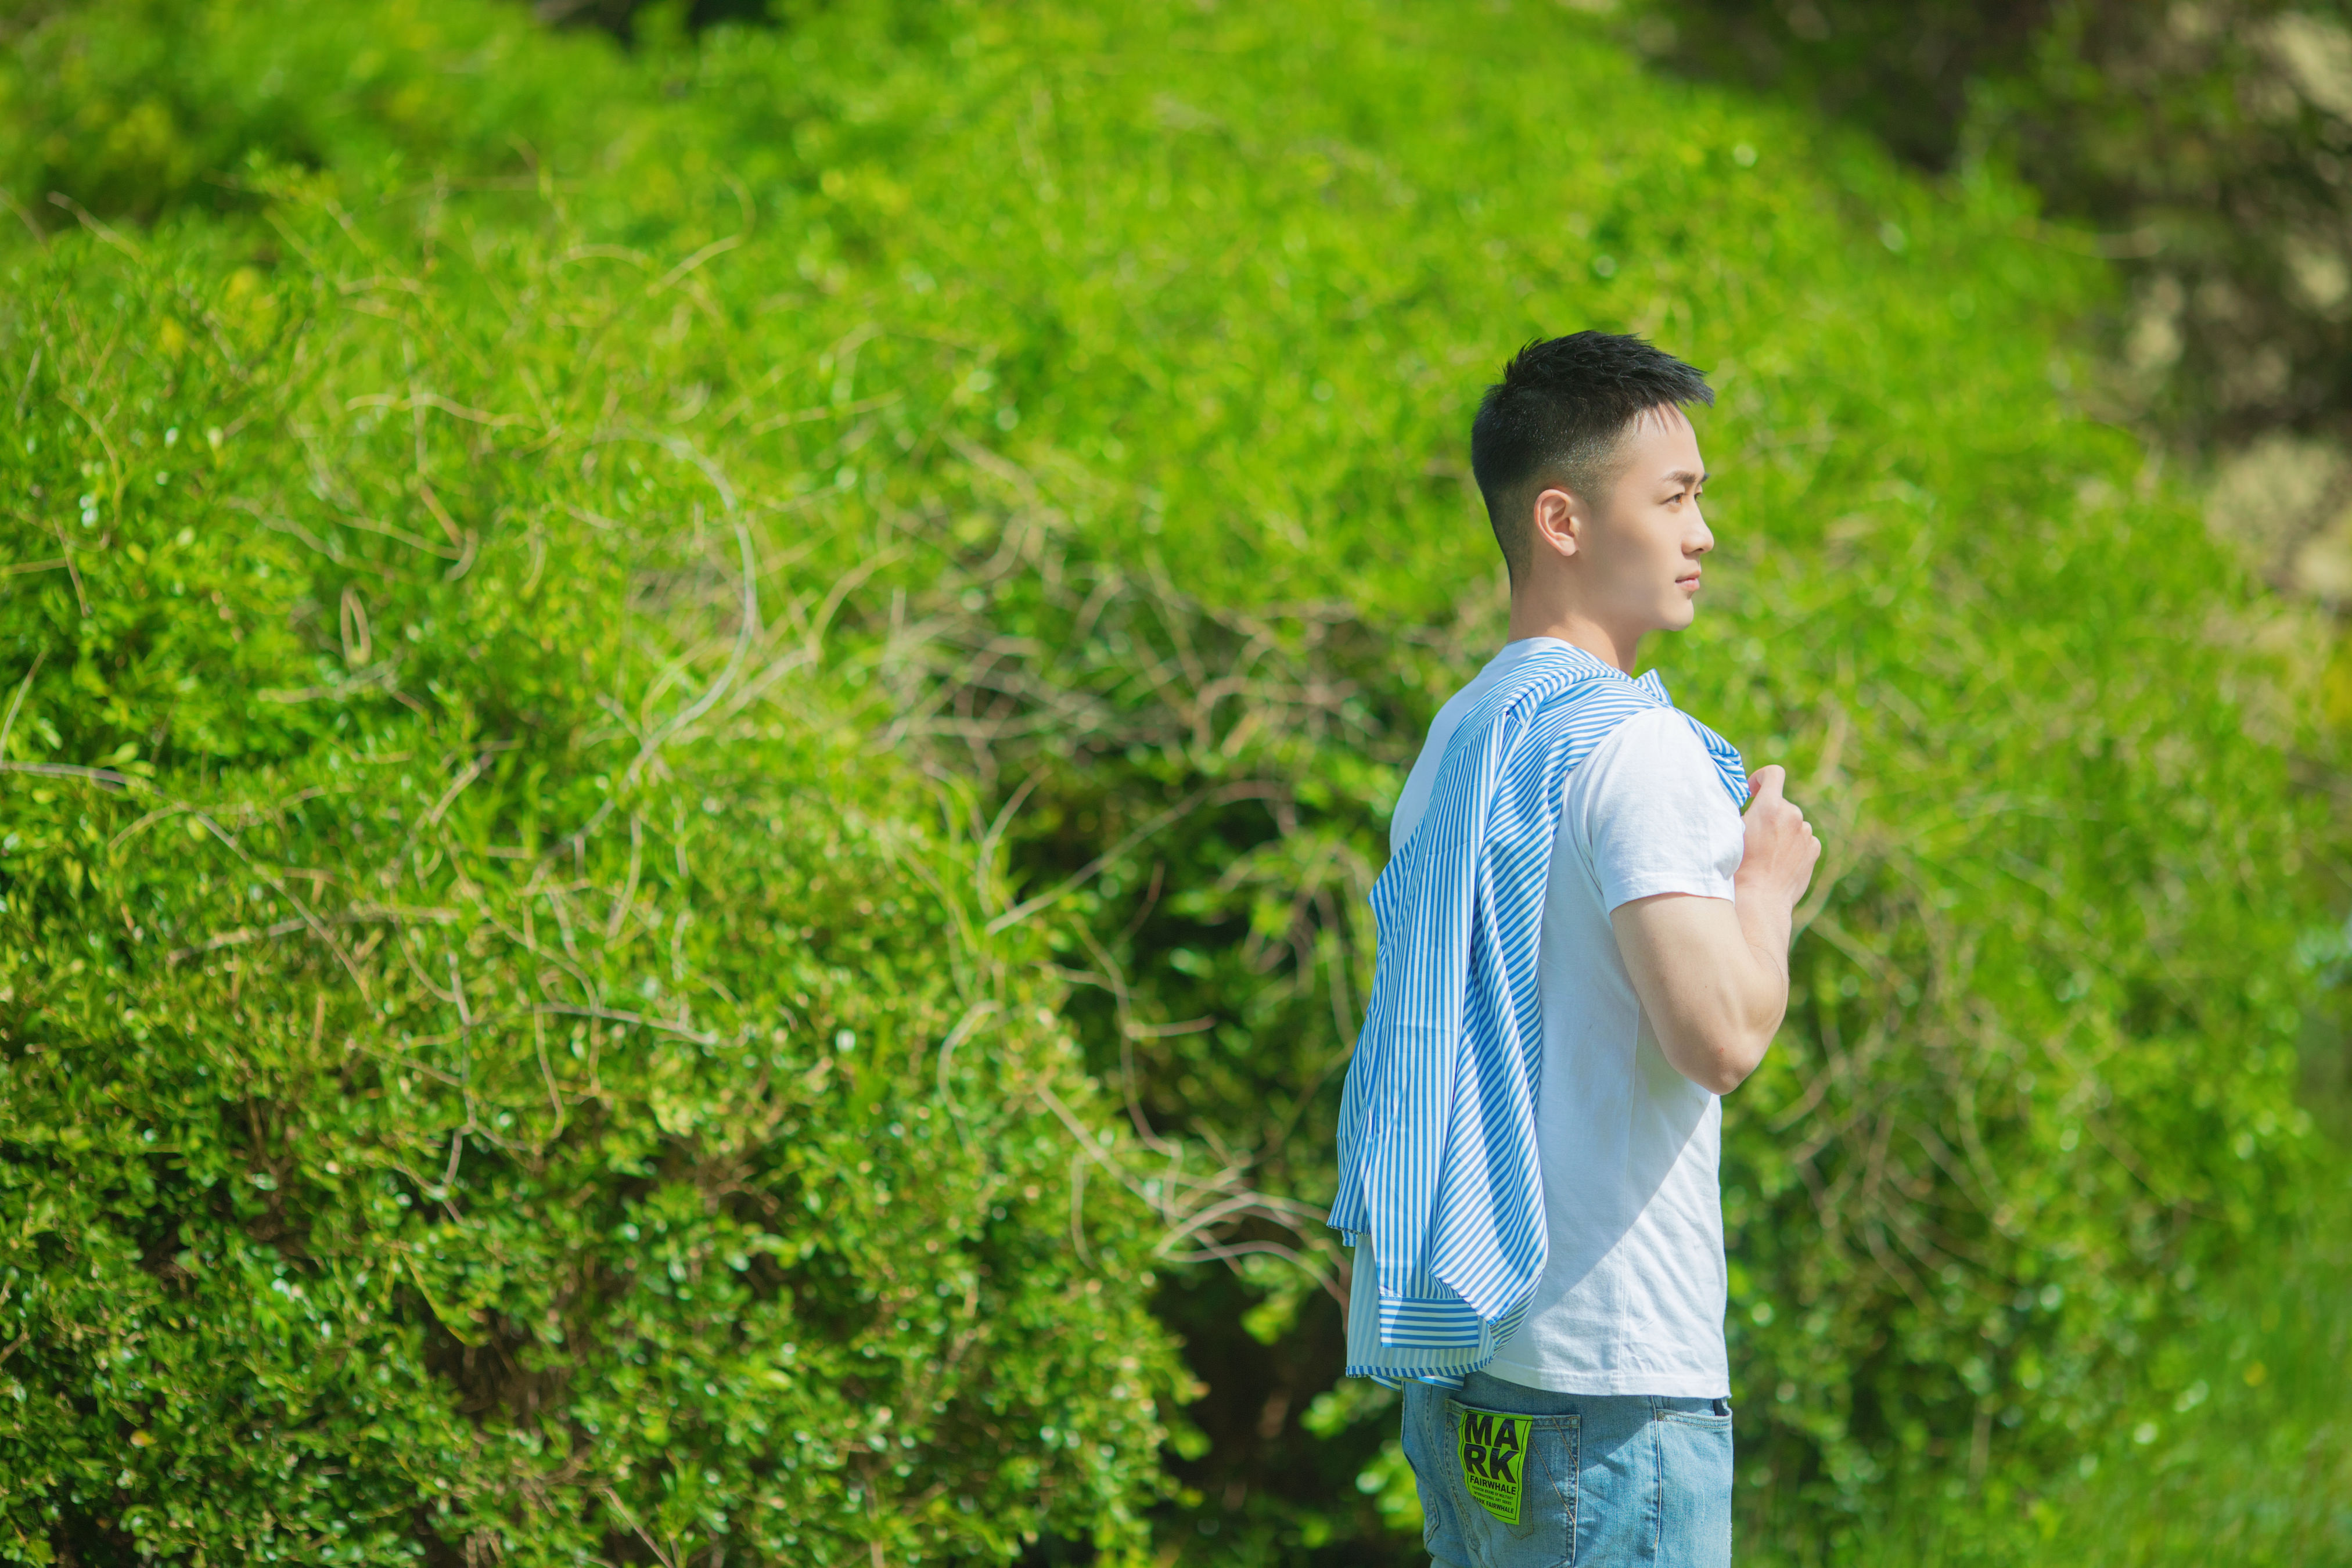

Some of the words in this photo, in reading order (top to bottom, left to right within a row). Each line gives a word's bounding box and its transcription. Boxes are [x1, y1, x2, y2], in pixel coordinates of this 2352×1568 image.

[1465, 1414, 1520, 1451] MA
[1464, 1443, 1520, 1484] RK
[1470, 1475, 1516, 1495] FAIRWHALE
[1474, 1491, 1494, 1501] INTERNATIONAL
[1486, 1501, 1514, 1514] FAIRWHALE
